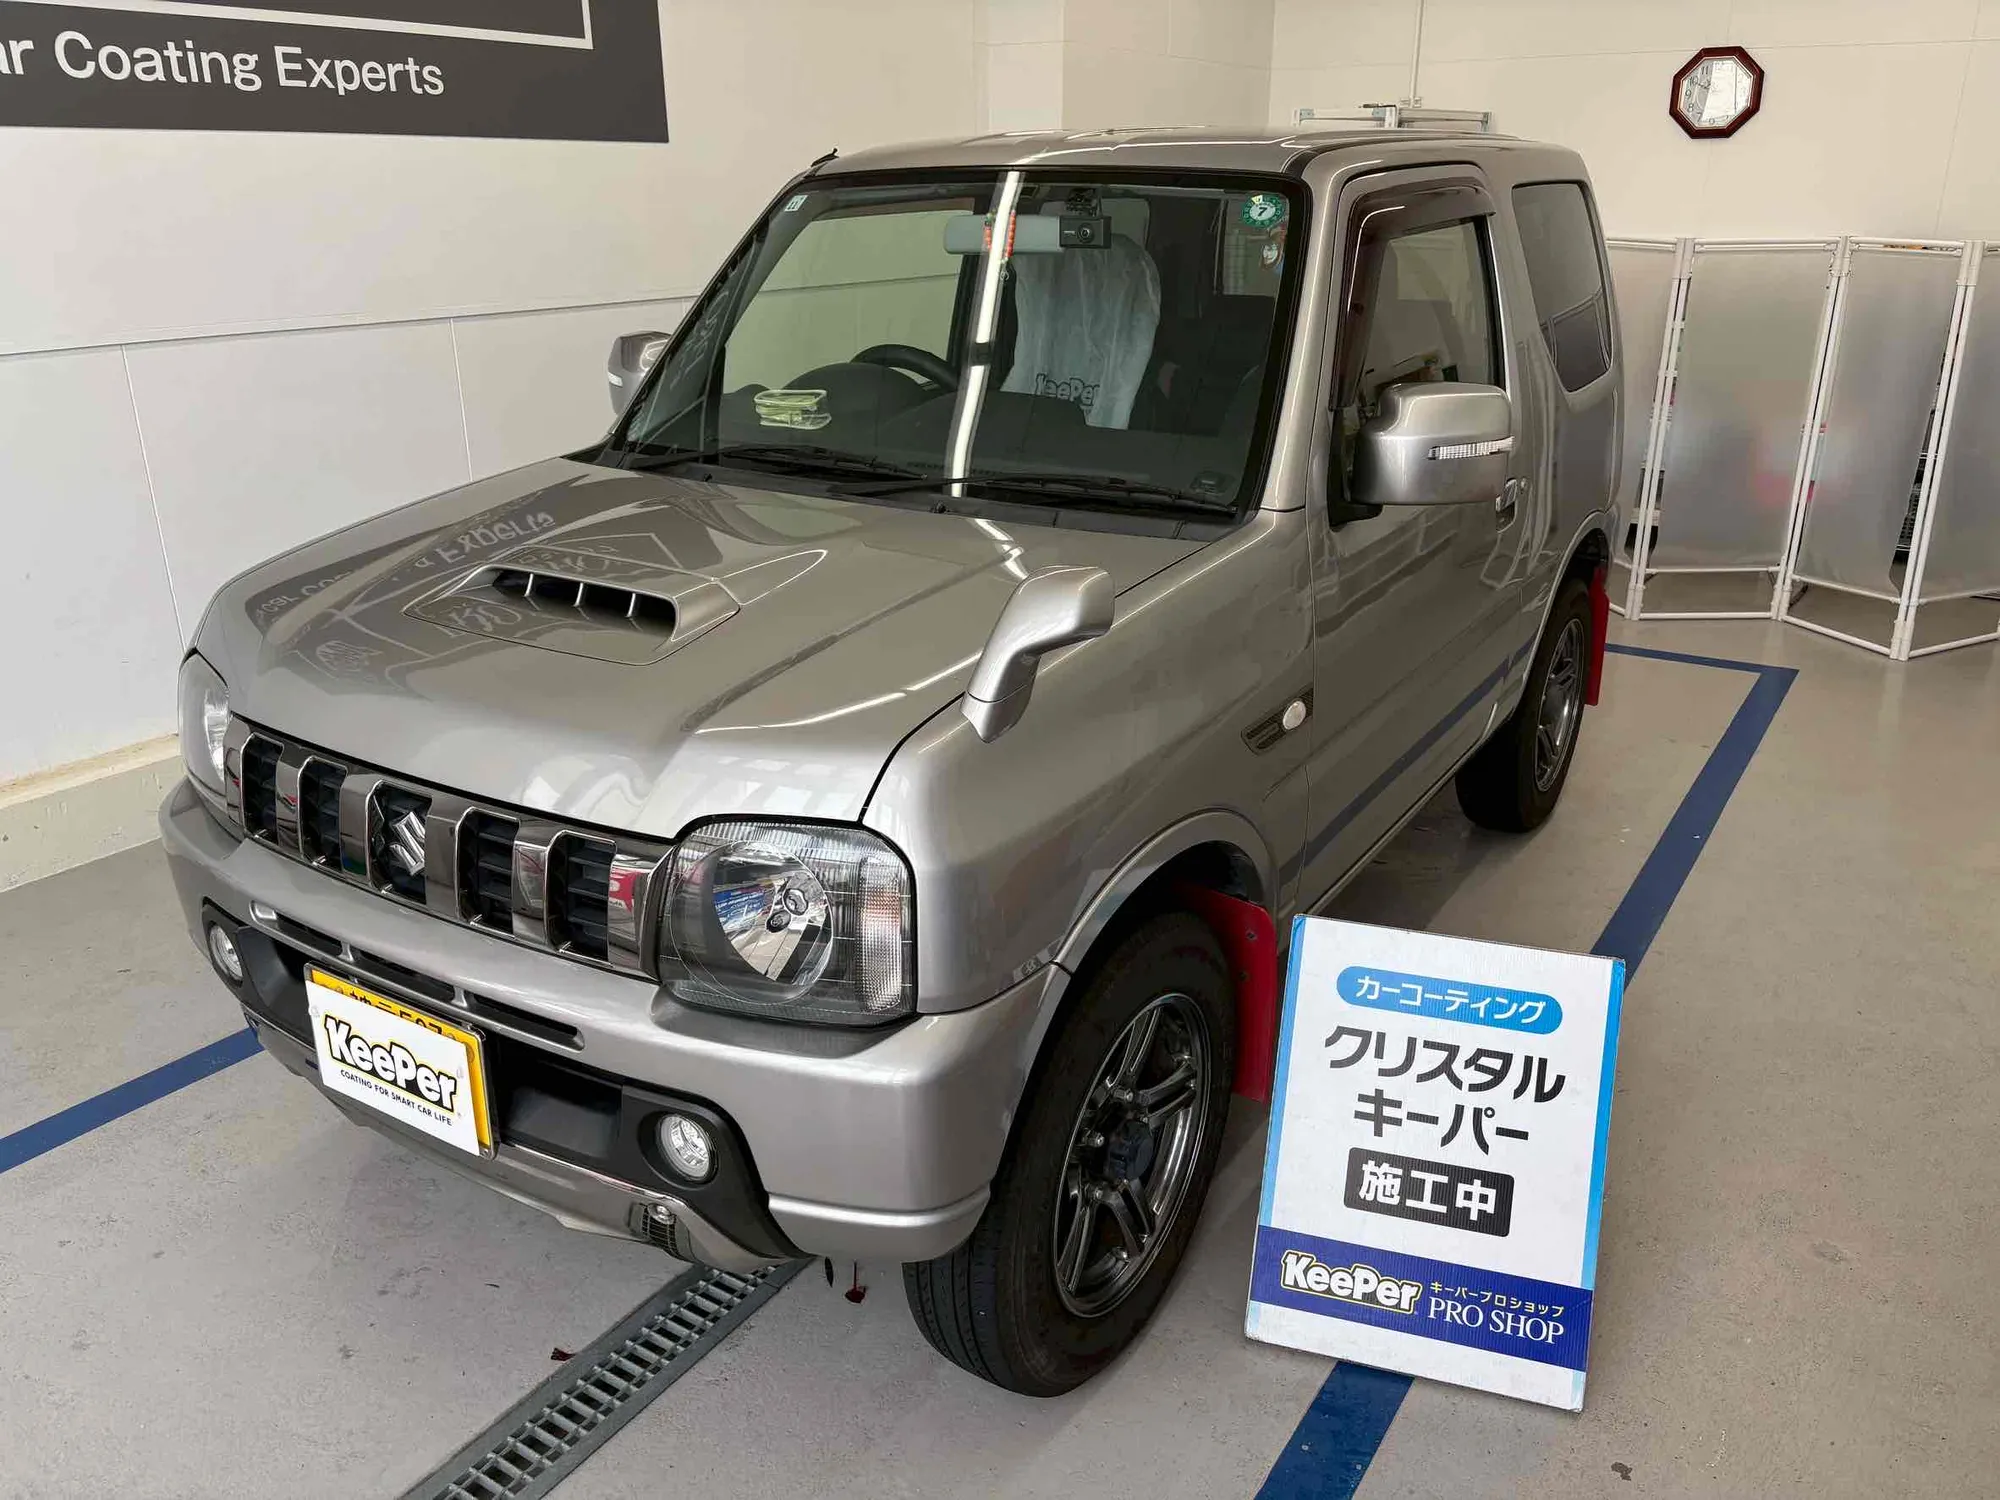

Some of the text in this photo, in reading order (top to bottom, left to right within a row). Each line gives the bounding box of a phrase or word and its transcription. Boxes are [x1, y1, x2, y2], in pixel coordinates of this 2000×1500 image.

[55, 30, 261, 91] Coating
[274, 46, 444, 96] Experts
[1258, 206, 1268, 217] 7
[1355, 976, 1546, 1024] カーコーティング
[324, 1014, 458, 1113] KeePer
[1324, 1025, 1566, 1103] クリスタル
[340, 1069, 452, 1127] COATING FOR SMART CAR LIFE
[1354, 1088, 1530, 1155] キーパー
[1358, 1161, 1497, 1222] 施工中
[1281, 1250, 1422, 1314] KeePer
[1428, 1296, 1565, 1345] PRO SHOP
